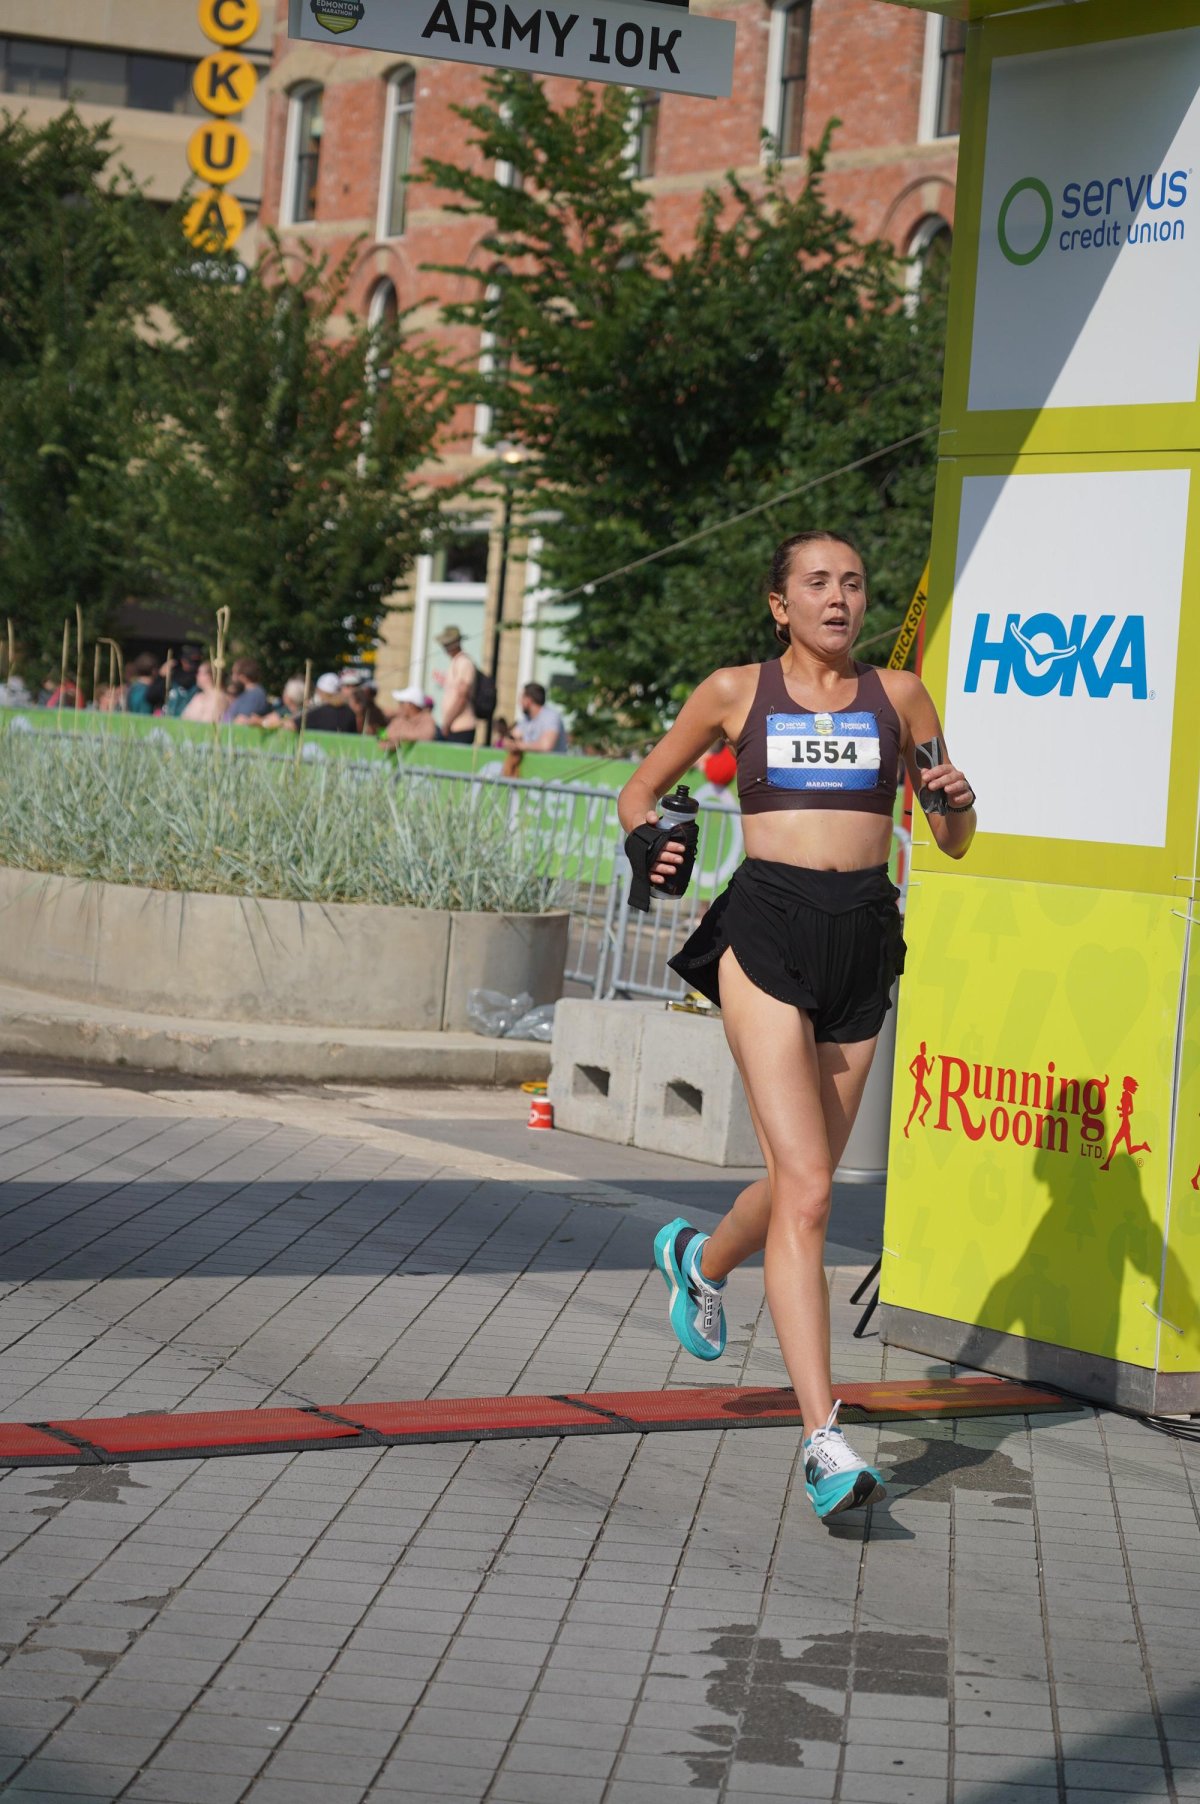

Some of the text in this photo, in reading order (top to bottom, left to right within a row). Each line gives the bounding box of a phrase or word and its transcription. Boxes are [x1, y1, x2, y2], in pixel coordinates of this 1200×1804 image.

[316, 0, 360, 12] EDMONTON
[321, 7, 353, 17] MARATHON
[421, 0, 683, 74] ARMY 10K
[1061, 170, 1188, 219] servus
[1059, 219, 1185, 251] credit union
[890, 591, 928, 671] ERICKSON
[963, 612, 1148, 700] HOKA
[791, 740, 858, 764] 1554
[806, 781, 843, 789] MARATHON
[933, 1055, 1109, 1142] Running
[1080, 1142, 1105, 1160] LTD.
